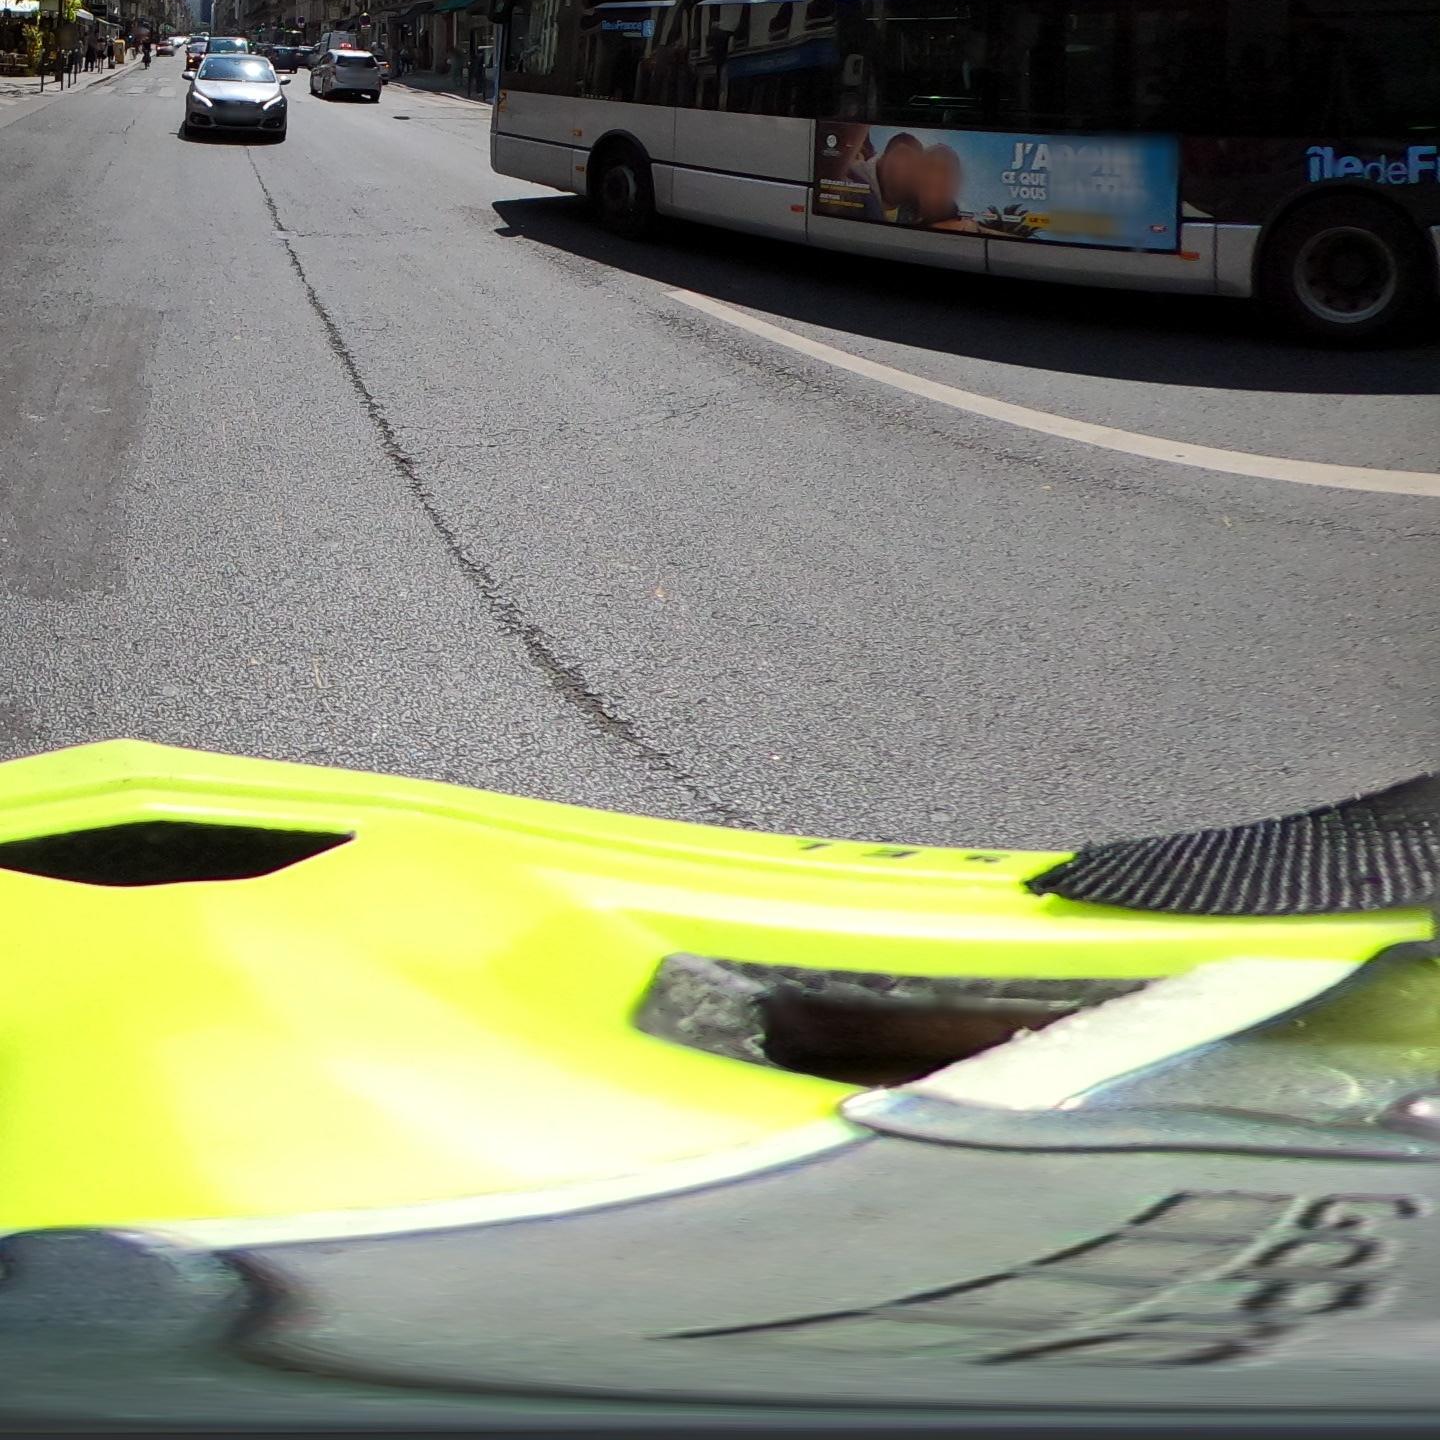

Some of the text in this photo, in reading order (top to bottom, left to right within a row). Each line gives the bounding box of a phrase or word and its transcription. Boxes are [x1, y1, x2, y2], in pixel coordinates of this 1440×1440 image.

[1001, 172, 1015, 185] CE
[1019, 172, 1047, 186] QUE
[1009, 186, 1046, 201] VOUS
